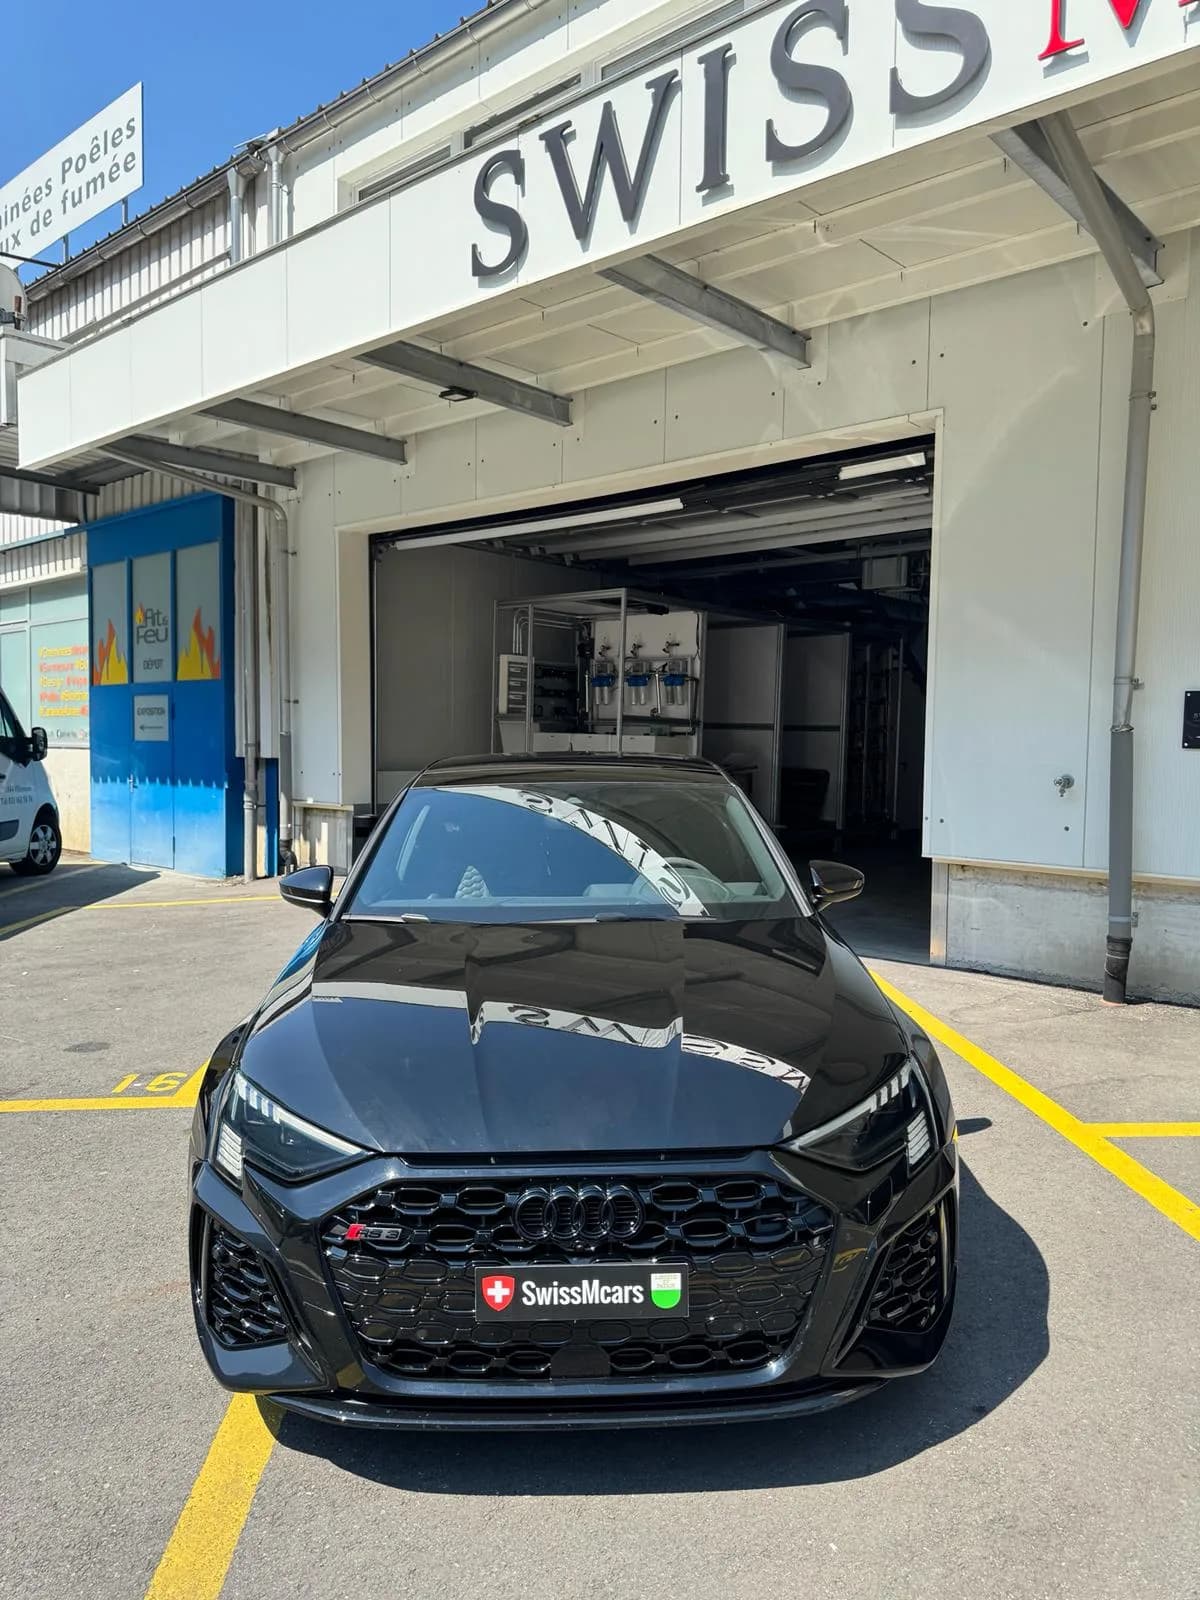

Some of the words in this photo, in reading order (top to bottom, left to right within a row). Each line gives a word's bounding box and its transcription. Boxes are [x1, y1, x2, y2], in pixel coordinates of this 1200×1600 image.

[61, 117, 136, 185] Poêles
[30, 208, 53, 238] de
[61, 150, 137, 216] fumée
[521, 1279, 645, 1307] SwissMcars
